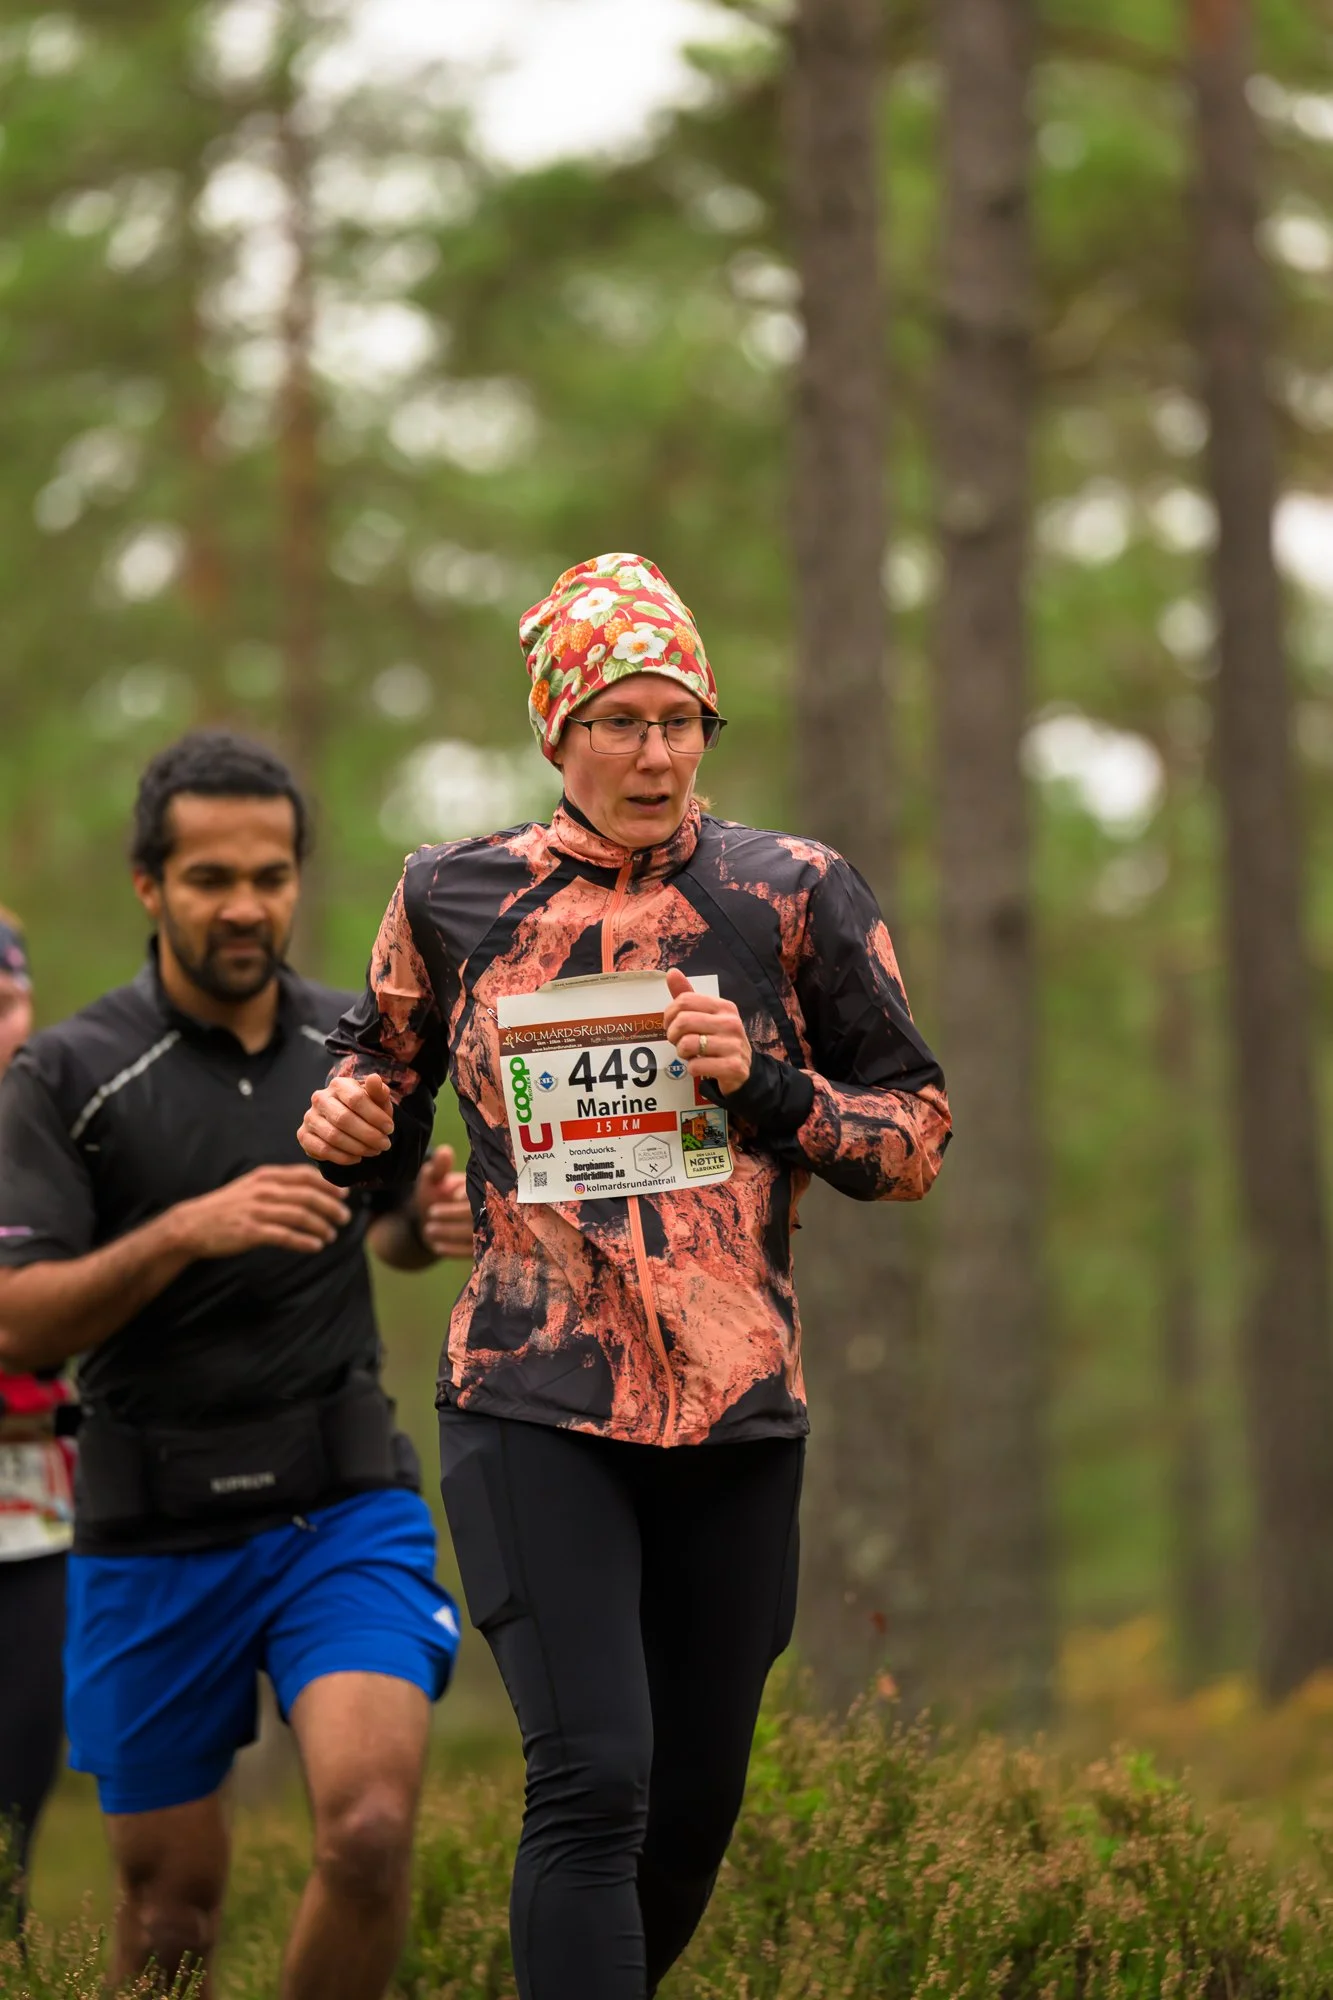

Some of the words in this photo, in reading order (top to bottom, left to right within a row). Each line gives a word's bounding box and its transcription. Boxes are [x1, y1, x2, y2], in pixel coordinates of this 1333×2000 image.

[568, 1046, 658, 1092] 449
[509, 1056, 533, 1124] coop
[577, 1094, 658, 1118] Marine
[596, 1121, 612, 1133] 15
[622, 1118, 641, 1131] KM
[615, 1169, 625, 1178] AB
[586, 1176, 676, 1193] kolmardsrundantrail
